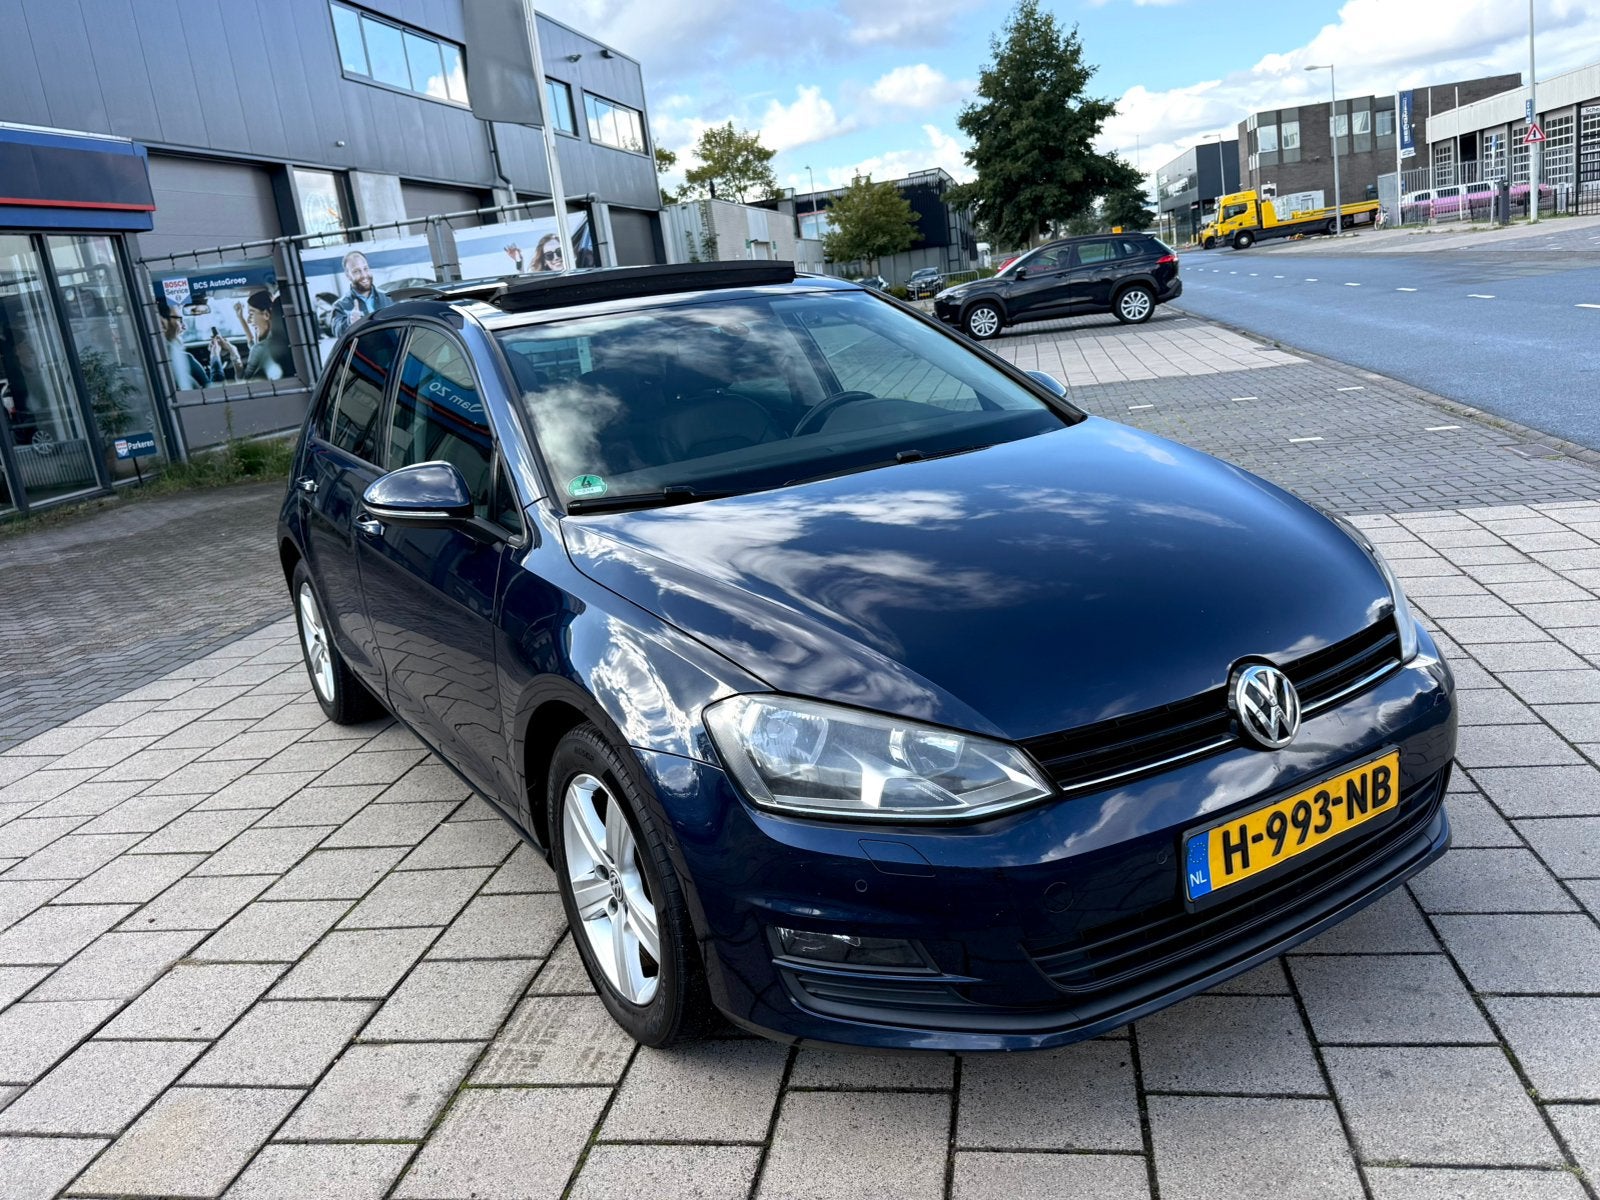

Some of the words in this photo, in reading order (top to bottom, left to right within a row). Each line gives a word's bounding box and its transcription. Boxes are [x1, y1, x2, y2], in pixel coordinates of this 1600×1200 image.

[164, 280, 187, 288] BOSCH
[193, 281, 208, 290] BCS
[209, 277, 247, 287] AutoGroep
[127, 440, 155, 450] Parkeren
[1237, 666, 1300, 748] VW
[1222, 765, 1392, 875] H-993-NB
[1189, 870, 1207, 887] NL
